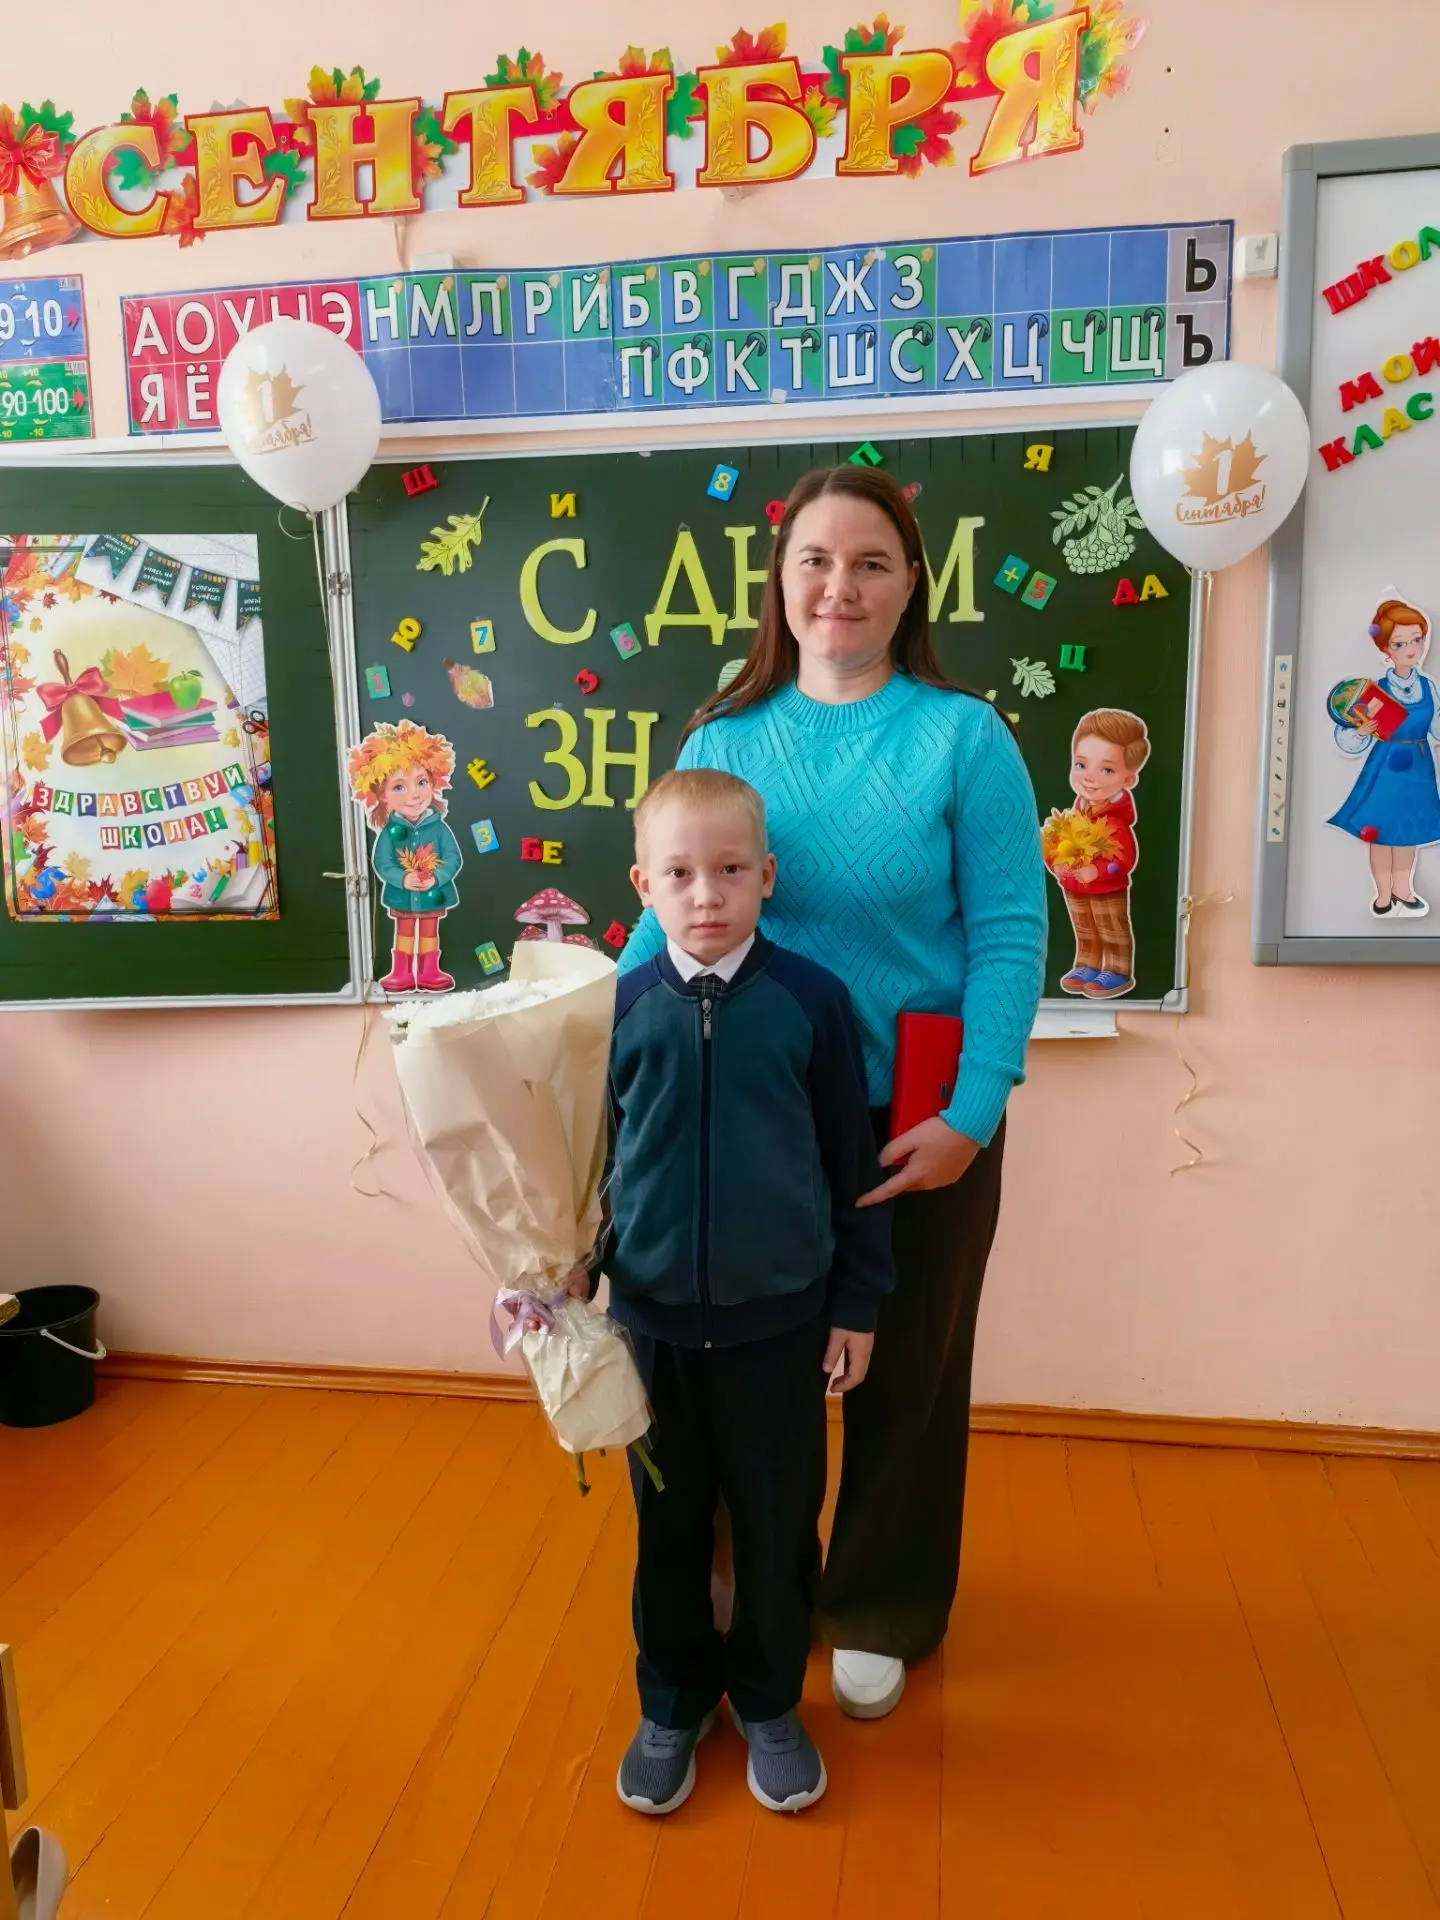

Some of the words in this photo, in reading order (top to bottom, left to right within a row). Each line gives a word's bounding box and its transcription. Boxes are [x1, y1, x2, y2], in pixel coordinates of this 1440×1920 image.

[66, 7, 1089, 239] СЕНТЯБРЯ
[25, 300, 63, 338] 10
[2, 390, 27, 416] 90
[33, 387, 69, 415] 100
[1024, 444, 1054, 472] Я
[1213, 449, 1234, 495] 1
[713, 471, 732, 492] 8
[1176, 484, 1265, 521] Сентября!
[519, 538, 597, 645] С
[1112, 574, 1169, 607] ДА
[391, 618, 422, 653] Ю
[474, 626, 488, 646] 7
[618, 632, 635, 652] 6
[371, 673, 386, 692] 1
[102, 811, 221, 846] ШКОЛА!
[521, 837, 564, 865] БЕ
[603, 920, 627, 948] В
[479, 949, 500, 968] 10
